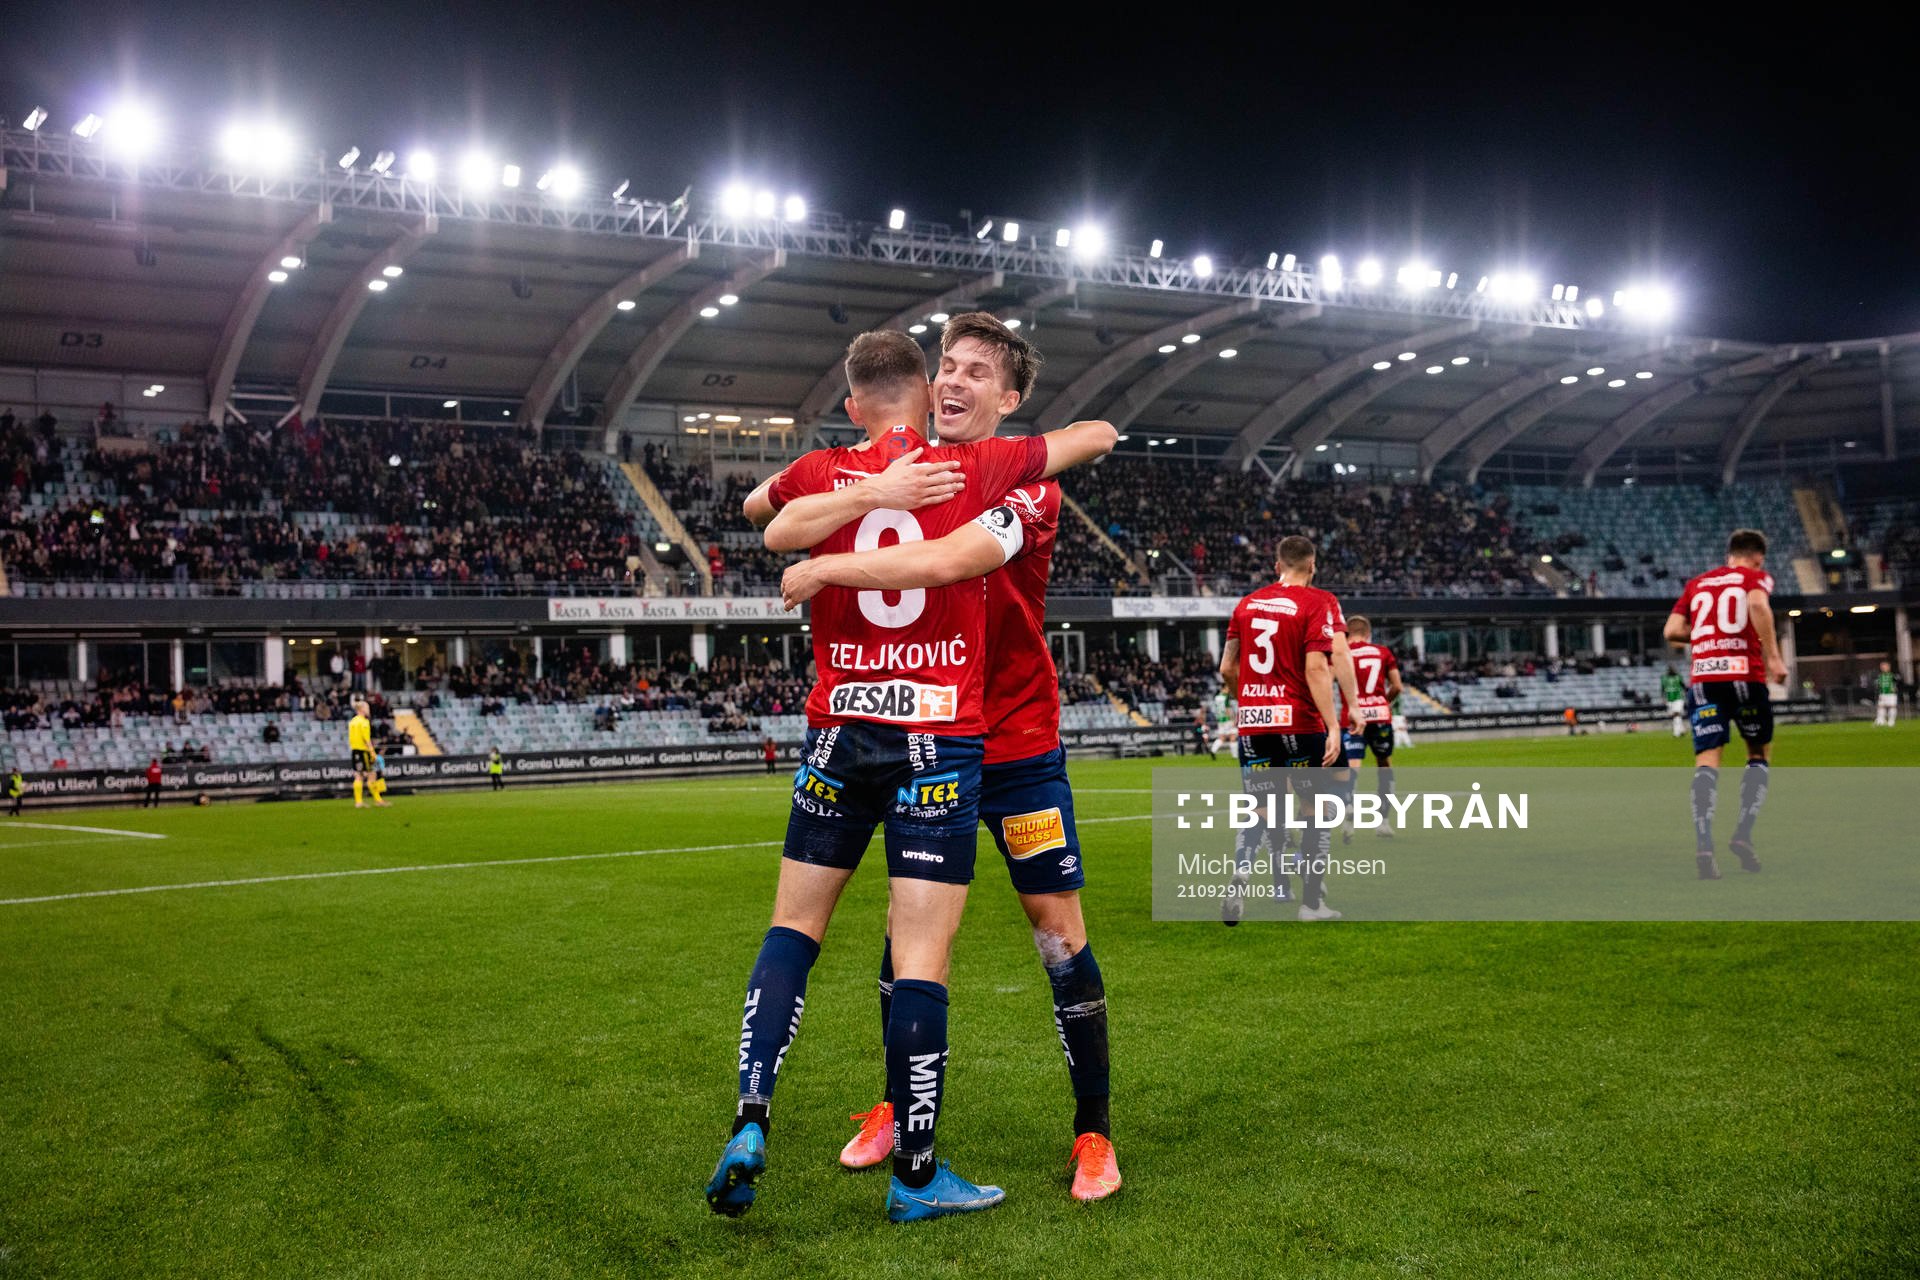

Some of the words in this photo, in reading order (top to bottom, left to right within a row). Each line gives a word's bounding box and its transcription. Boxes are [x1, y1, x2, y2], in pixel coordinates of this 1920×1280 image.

[61, 332, 104, 348] D3
[409, 355, 447, 369] D4
[702, 373, 737, 387] D5
[555, 606, 591, 618] RASTA
[600, 606, 634, 618] RASTA
[643, 606, 677, 618] RASTA
[685, 606, 718, 618] RASTA
[726, 606, 759, 618] RASTA
[1690, 587, 1748, 640] 20
[829, 633, 966, 670] ZELJKOVIĆ
[1249, 618, 1279, 675] 3
[1358, 658, 1382, 694] 7
[833, 685, 915, 717] BESAB
[1242, 683, 1286, 698] AZULAY
[21, 780, 55, 794] amla
[57, 777, 97, 792] Ullevi
[104, 775, 148, 791] Gamla
[162, 772, 188, 788] llevi
[194, 771, 237, 785] Gamla
[239, 769, 275, 783] Ullevi
[280, 767, 321, 781] Gamla
[322, 763, 355, 778] Ullev
[403, 762, 436, 776] Ullevi
[441, 760, 477, 774] Gamla
[516, 758, 552, 770] Gamla
[554, 756, 584, 769] Ullevi
[589, 756, 624, 768] Gamla
[625, 753, 654, 765] Ullevi
[659, 753, 693, 764] Gamla
[694, 751, 722, 763] Ullevi
[1007, 815, 1057, 836] TRIUMF
[1016, 830, 1051, 846] GLASS
[902, 850, 944, 863] umbro
[749, 1061, 763, 1094] umbro
[908, 1052, 940, 1132] MIKE
